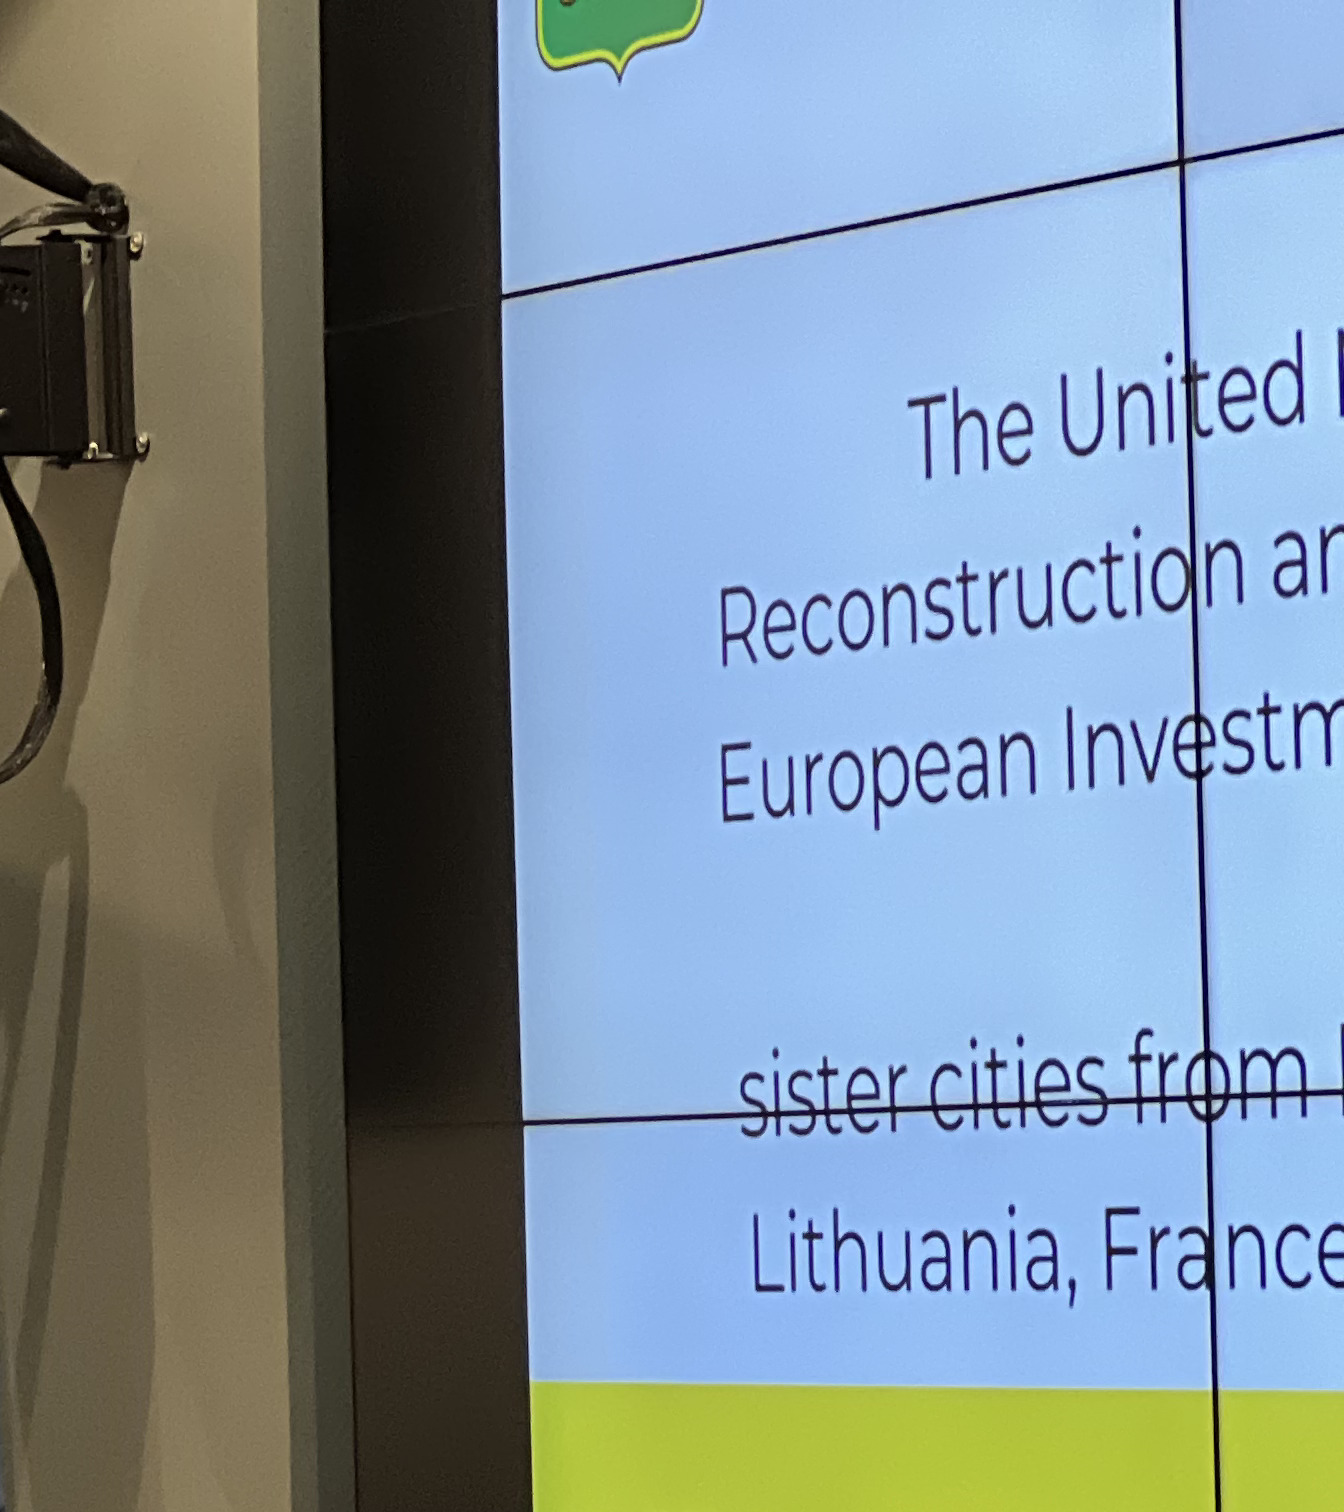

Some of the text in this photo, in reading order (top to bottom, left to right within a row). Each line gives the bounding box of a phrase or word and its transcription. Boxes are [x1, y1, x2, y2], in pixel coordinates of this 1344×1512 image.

[906, 386, 1034, 481] The
[1060, 328, 1306, 458] United
[719, 525, 1245, 668] Reconstruction
[720, 727, 1038, 831] European
[739, 1048, 909, 1138] sister
[930, 1033, 1110, 1130] cities
[1128, 1027, 1309, 1125] from
[752, 1203, 1078, 1308] Lithuania,
